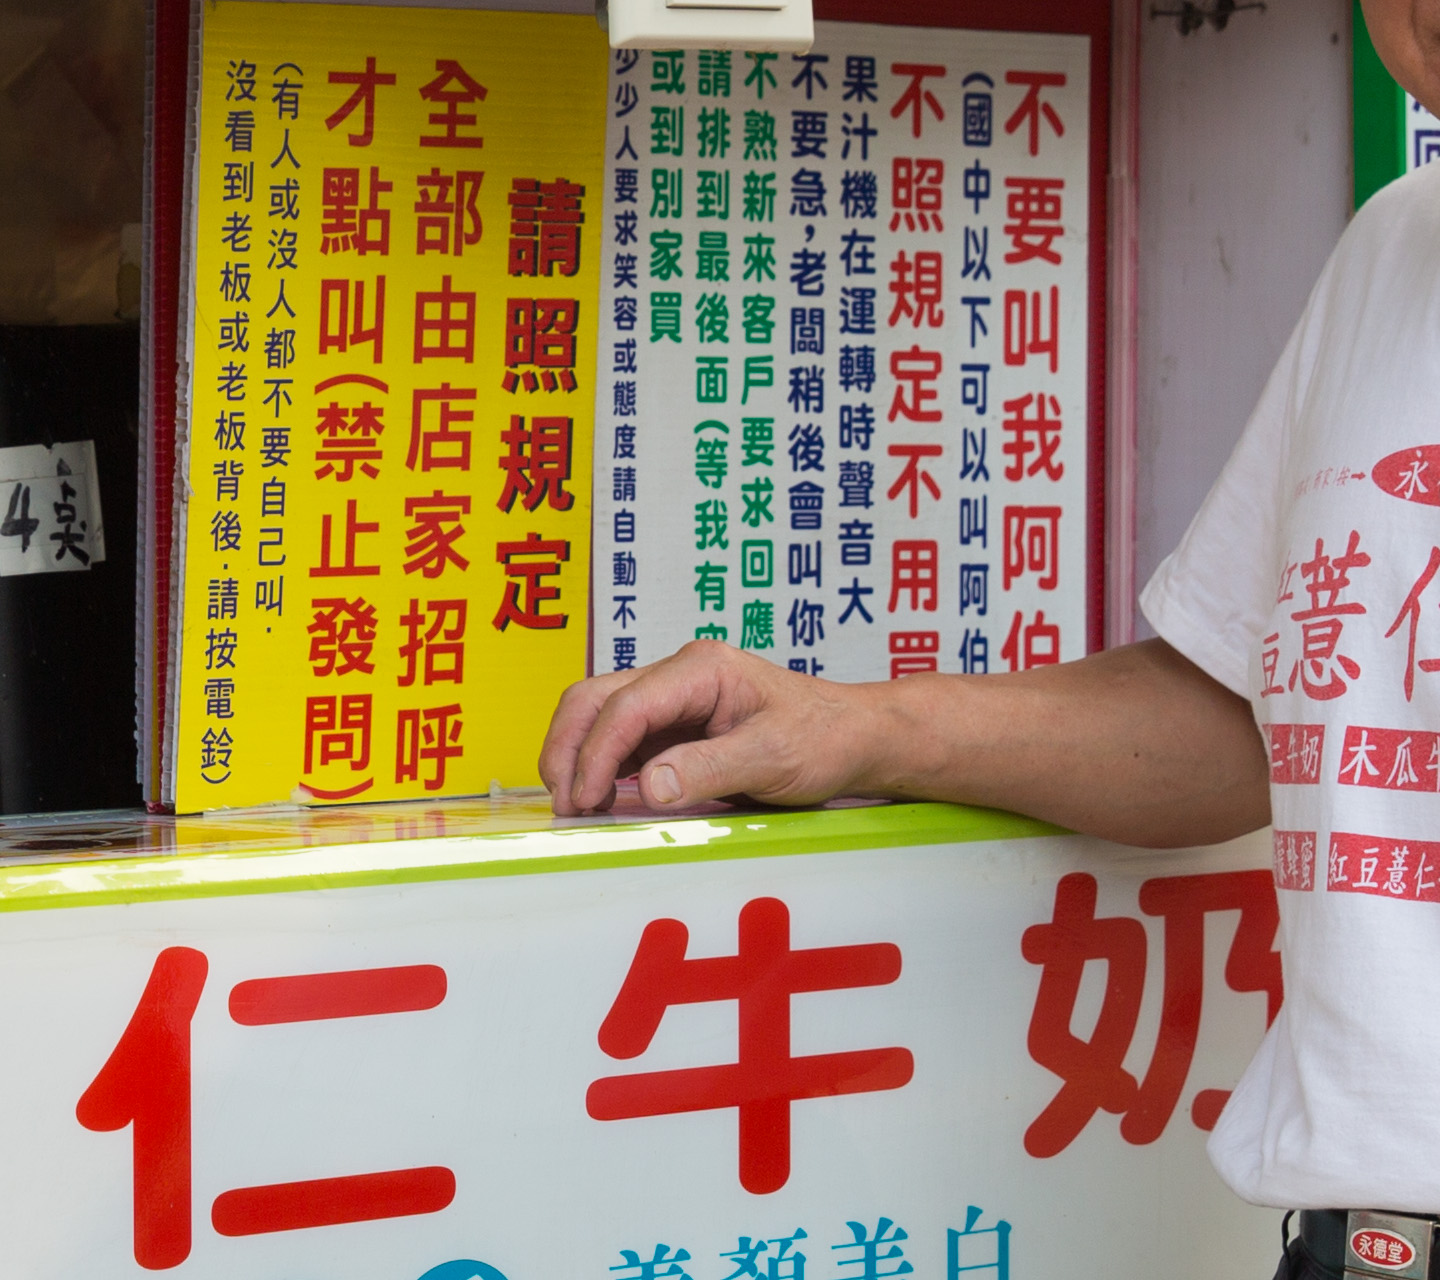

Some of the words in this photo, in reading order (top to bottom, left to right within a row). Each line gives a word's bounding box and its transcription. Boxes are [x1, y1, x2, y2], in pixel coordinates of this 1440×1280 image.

[394, 58, 489, 792] 全部由店家招呼
[491, 176, 587, 634] 請照規定
[837, 55, 879, 625] 果汁機在運轉時聲音大
[1000, 70, 1067, 675] 不要叫我阿伯
[1357, 1233, 1404, 1264] 永德堂
